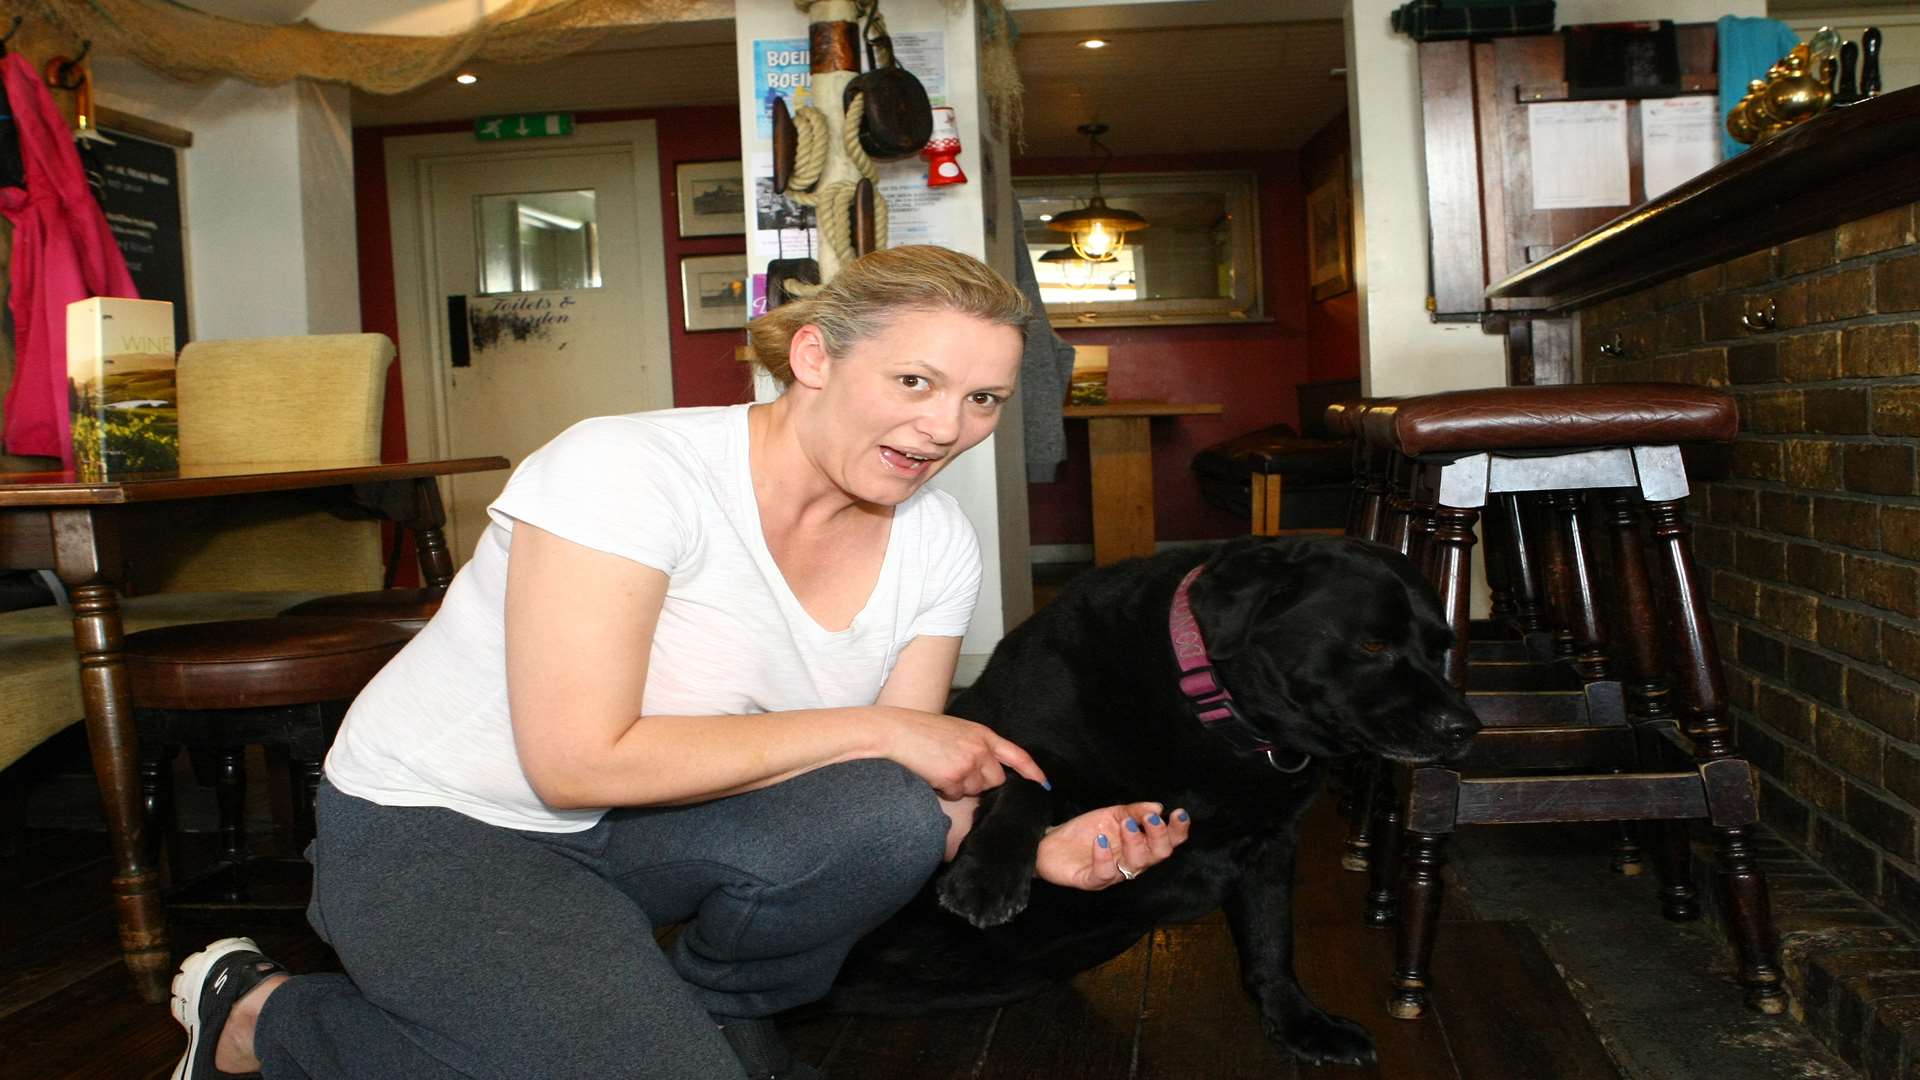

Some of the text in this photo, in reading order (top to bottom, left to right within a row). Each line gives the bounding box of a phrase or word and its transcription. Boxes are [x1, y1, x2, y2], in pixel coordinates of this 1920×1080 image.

[494, 296, 576, 311] Toilets &
[121, 335, 171, 353] WINE
